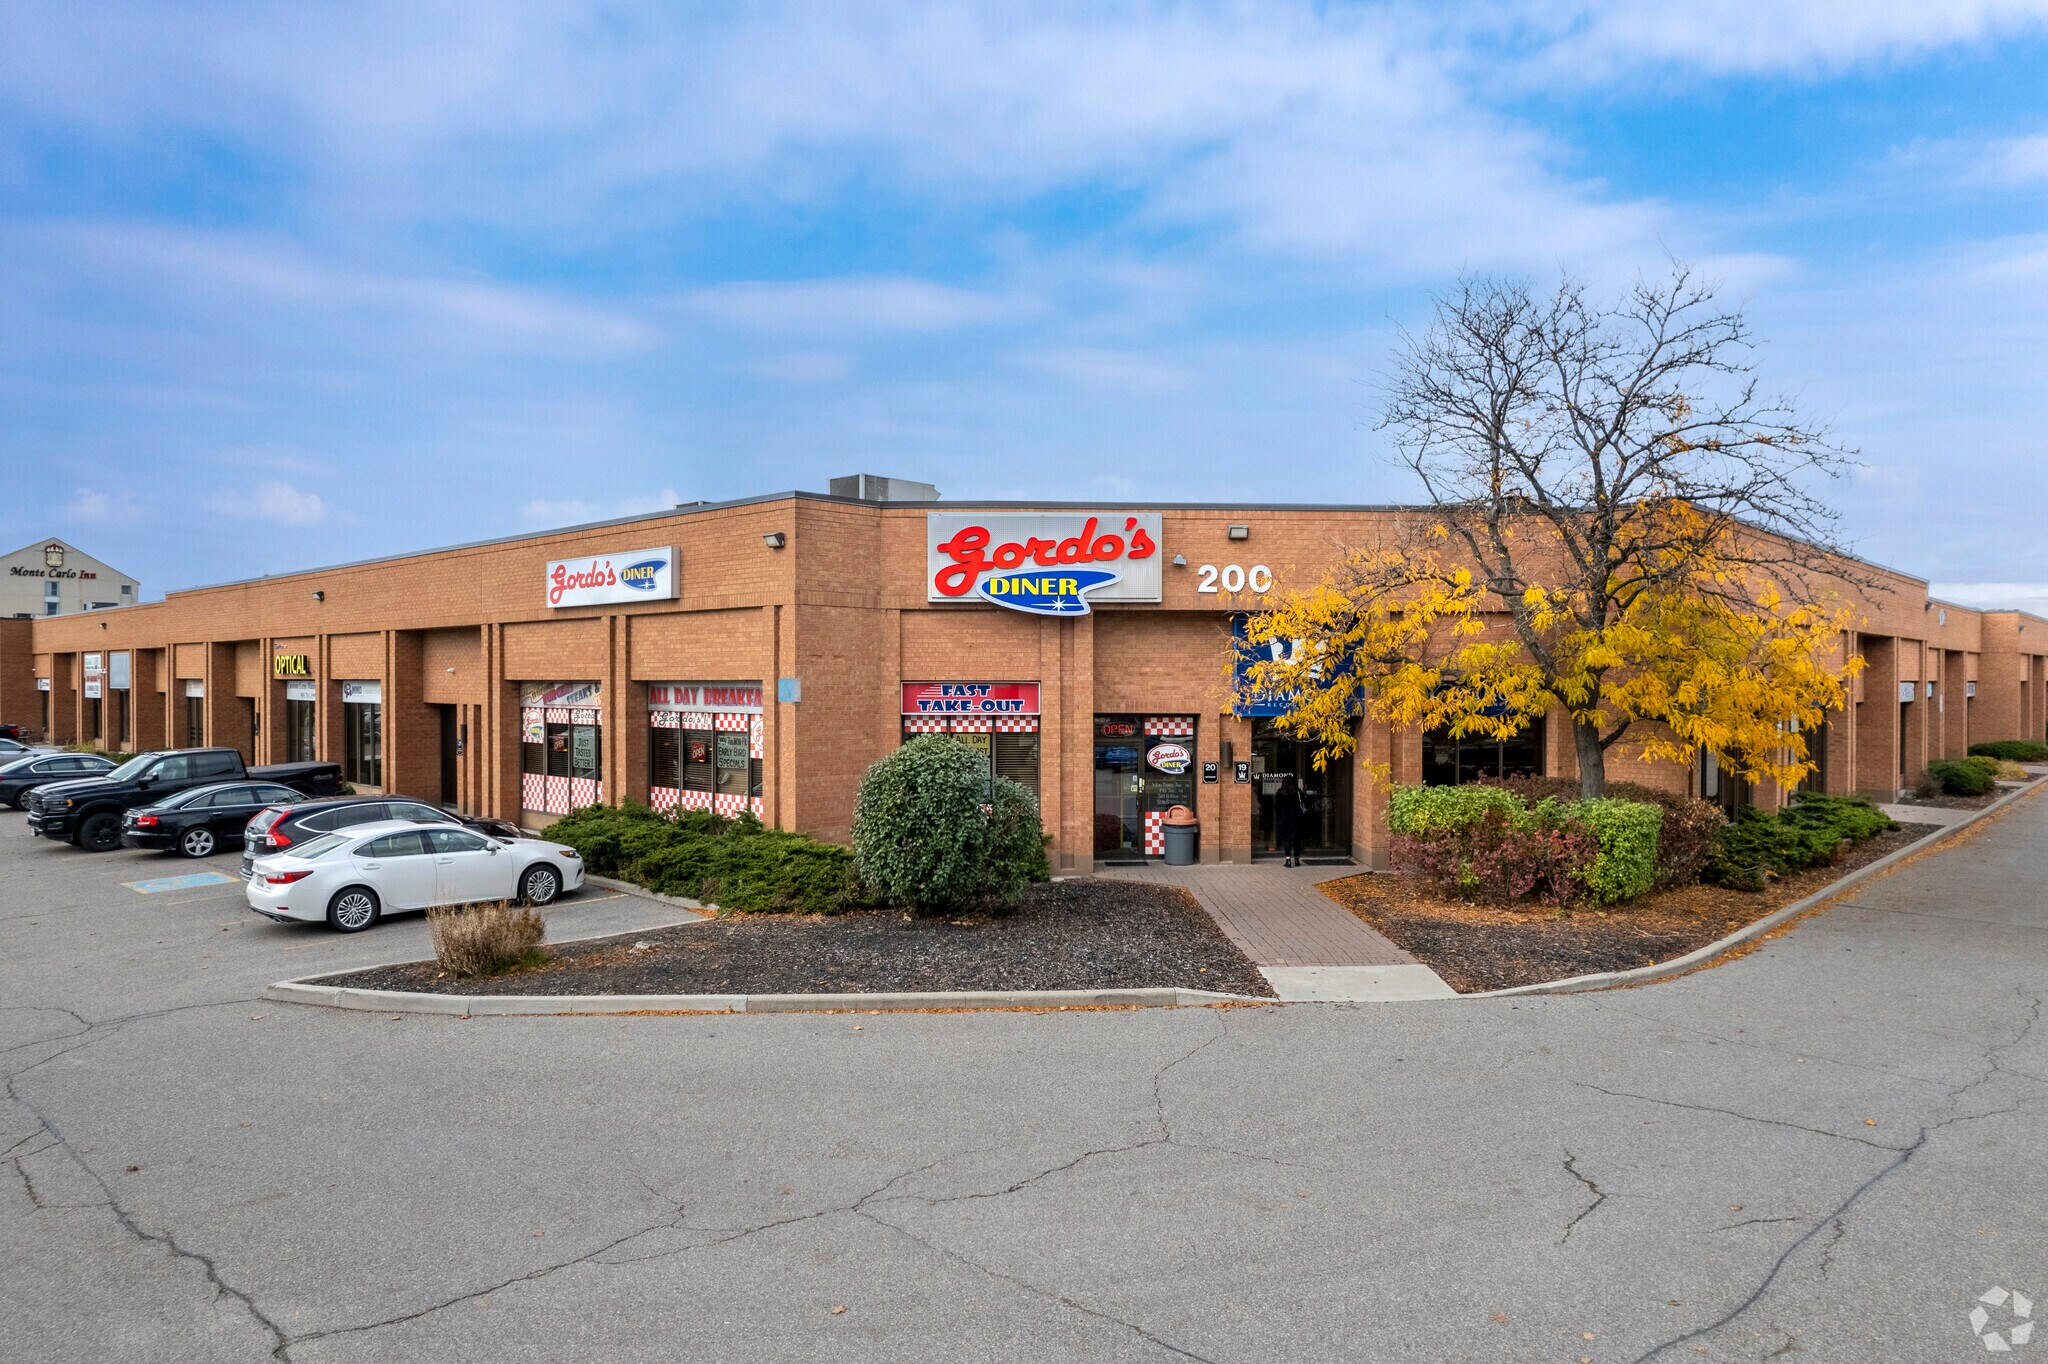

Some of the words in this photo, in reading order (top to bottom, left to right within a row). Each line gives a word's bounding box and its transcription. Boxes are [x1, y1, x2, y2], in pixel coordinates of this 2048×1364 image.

[934, 517, 1156, 596] Gordo's
[10, 566, 45, 577] Monte
[48, 568, 77, 579] Carlo
[79, 570, 97, 580] Inn
[1197, 564, 1273, 593] 200
[549, 560, 617, 604] Gordo's
[622, 566, 654, 580] DINER
[989, 577, 1078, 596] DINER
[275, 655, 306, 675] OPTICAL
[566, 684, 592, 706] STEAKS
[650, 686, 670, 705] ALL
[674, 686, 699, 705] DAY
[703, 686, 762, 707] BREAKFA
[941, 684, 991, 697] FAST
[917, 699, 1025, 712] TAKE-OUT
[574, 709, 595, 722] Gotta
[1103, 724, 1133, 735] OPEN
[578, 739, 589, 747] JUST
[956, 735, 970, 743] ALL
[972, 735, 987, 744] DAY
[575, 747, 591, 757] TASTES
[719, 747, 732, 756] EARLY
[734, 747, 747, 757] BIRD
[1152, 748, 1184, 764] Gordo's
[719, 757, 745, 768] SPECIALS
[1205, 763, 1216, 771] 20
[1238, 763, 1247, 771] 19
